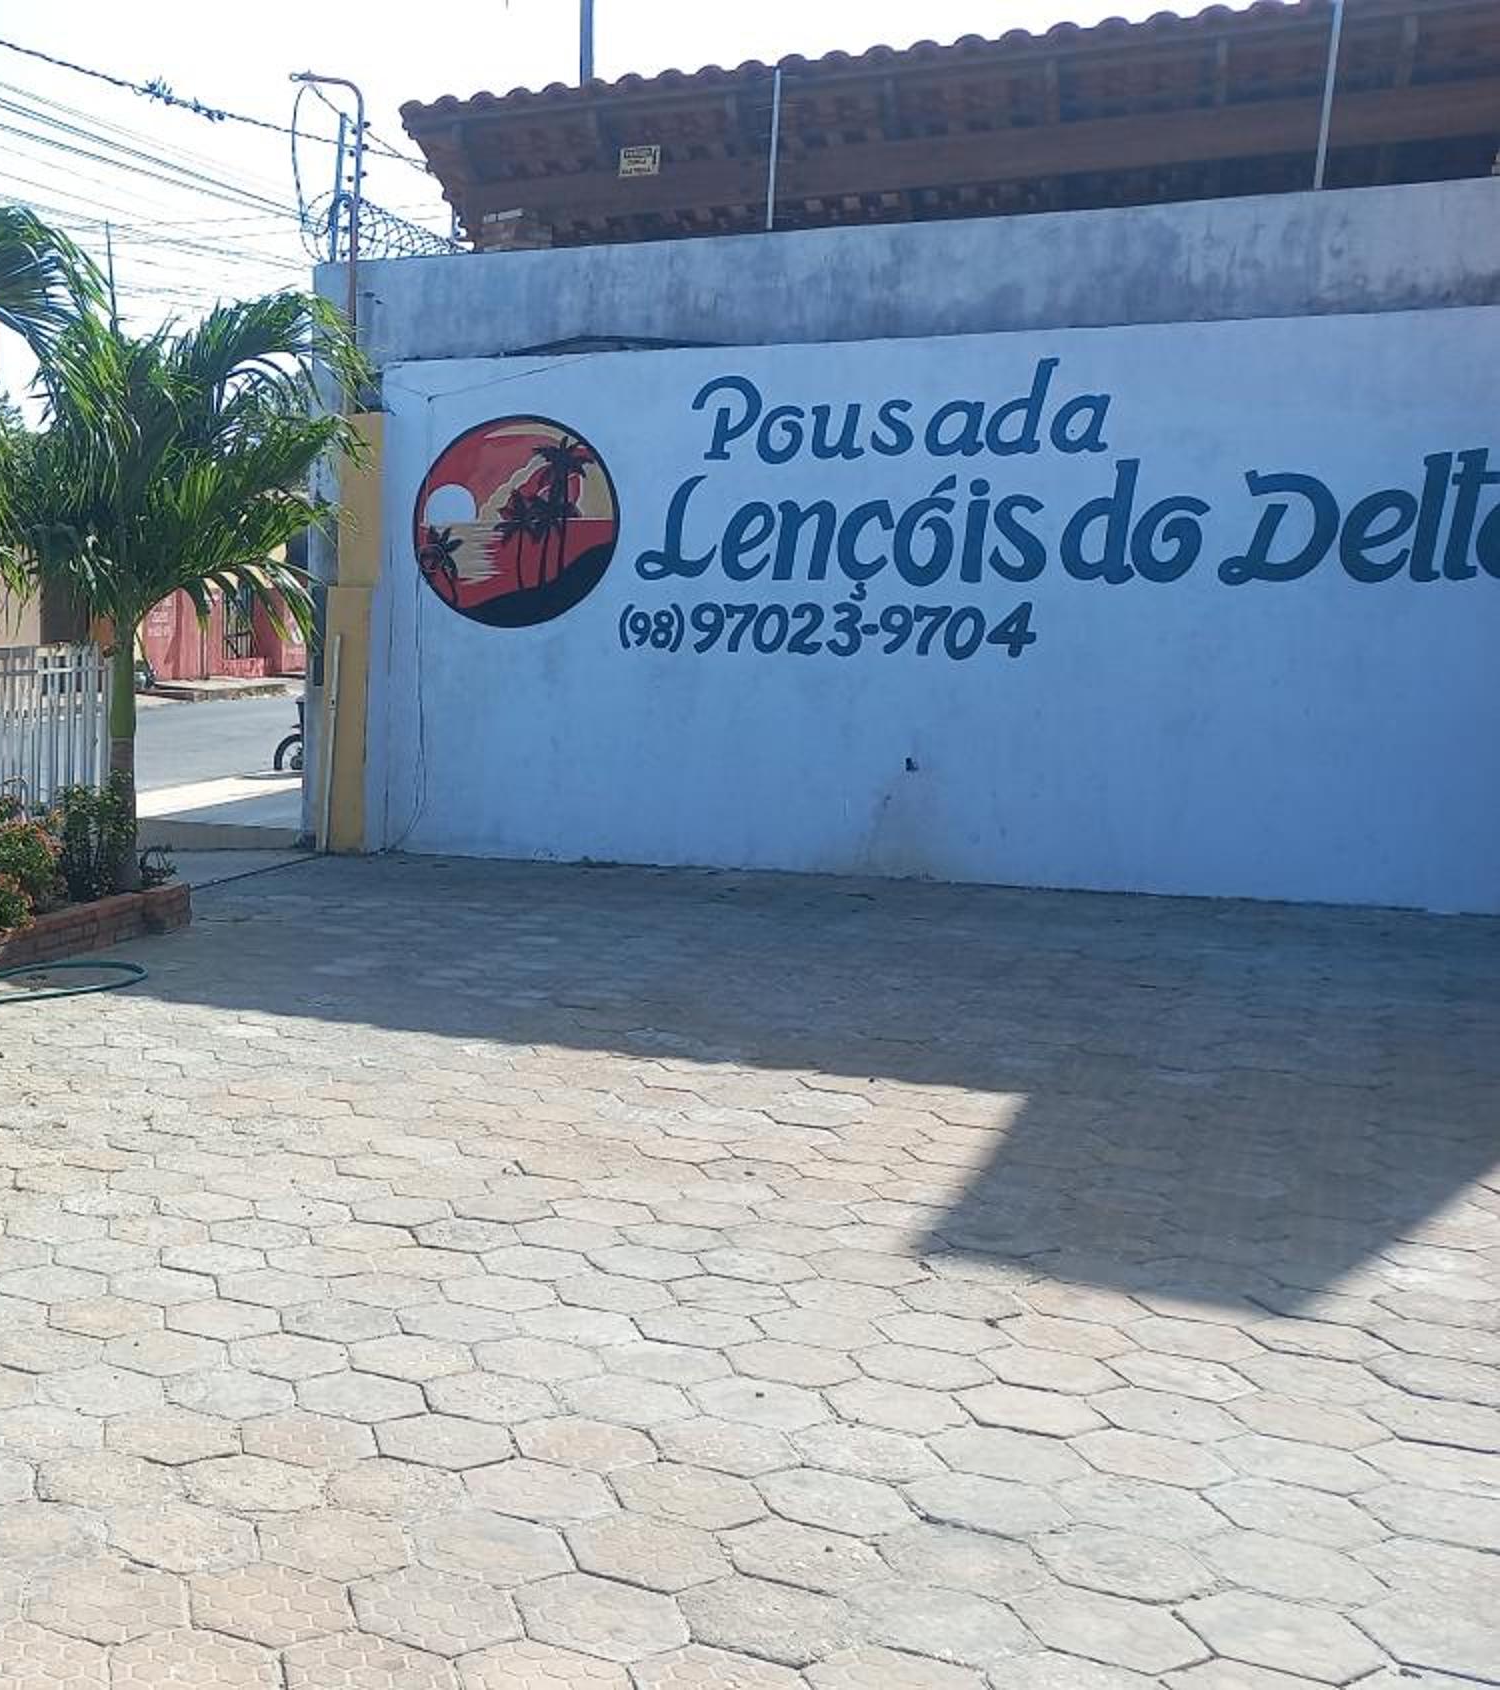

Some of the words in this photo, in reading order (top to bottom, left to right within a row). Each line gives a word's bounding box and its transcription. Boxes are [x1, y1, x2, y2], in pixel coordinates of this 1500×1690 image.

[691, 357, 1111, 465] Pousada
[634, 473, 1048, 602] Lençóis
[1059, 457, 1212, 586] do
